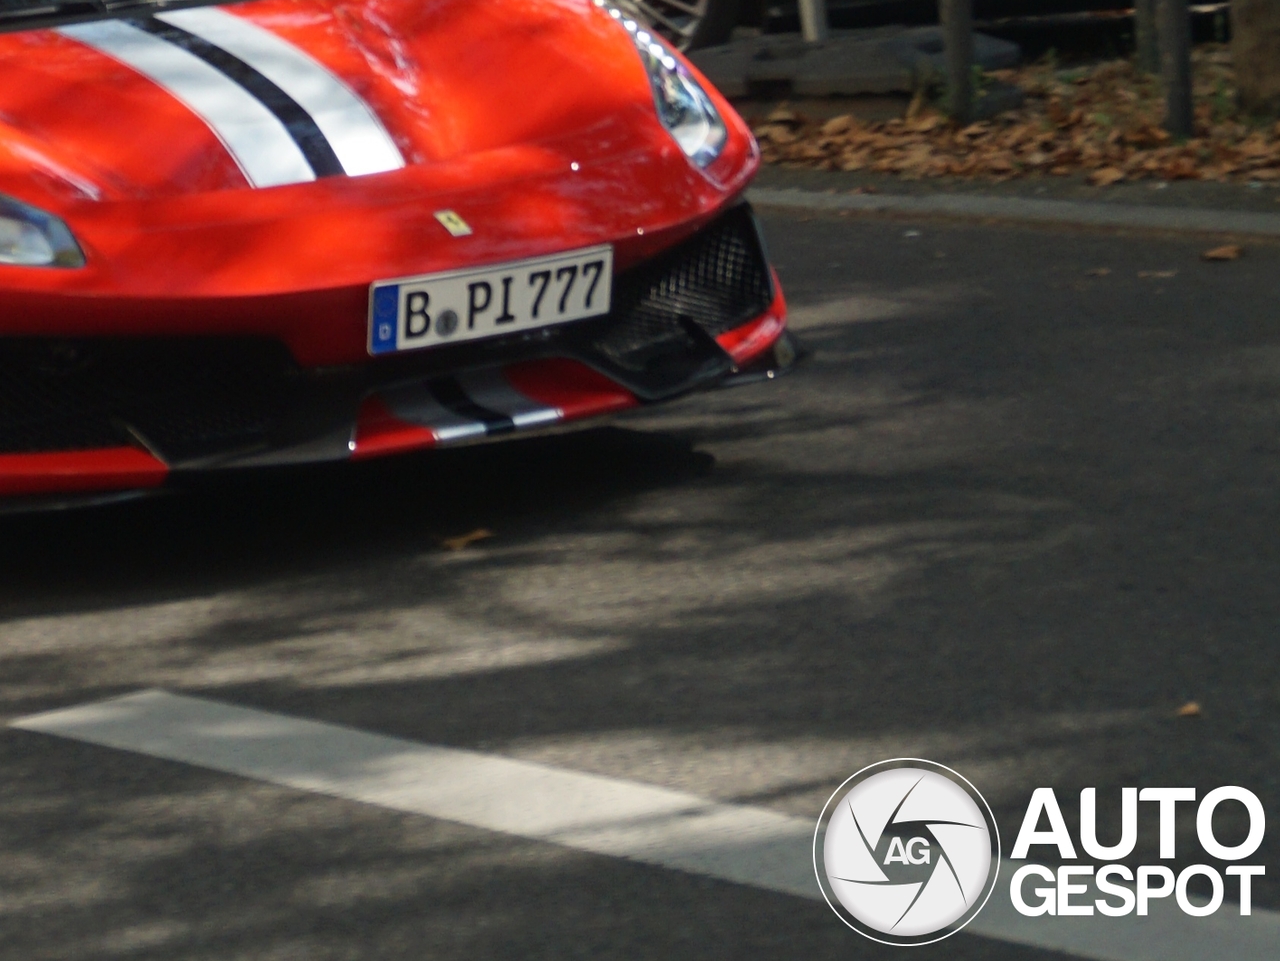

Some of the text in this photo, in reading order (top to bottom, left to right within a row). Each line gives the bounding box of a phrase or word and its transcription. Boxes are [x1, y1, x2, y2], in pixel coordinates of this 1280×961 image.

[405, 260, 604, 339] B PI 777
